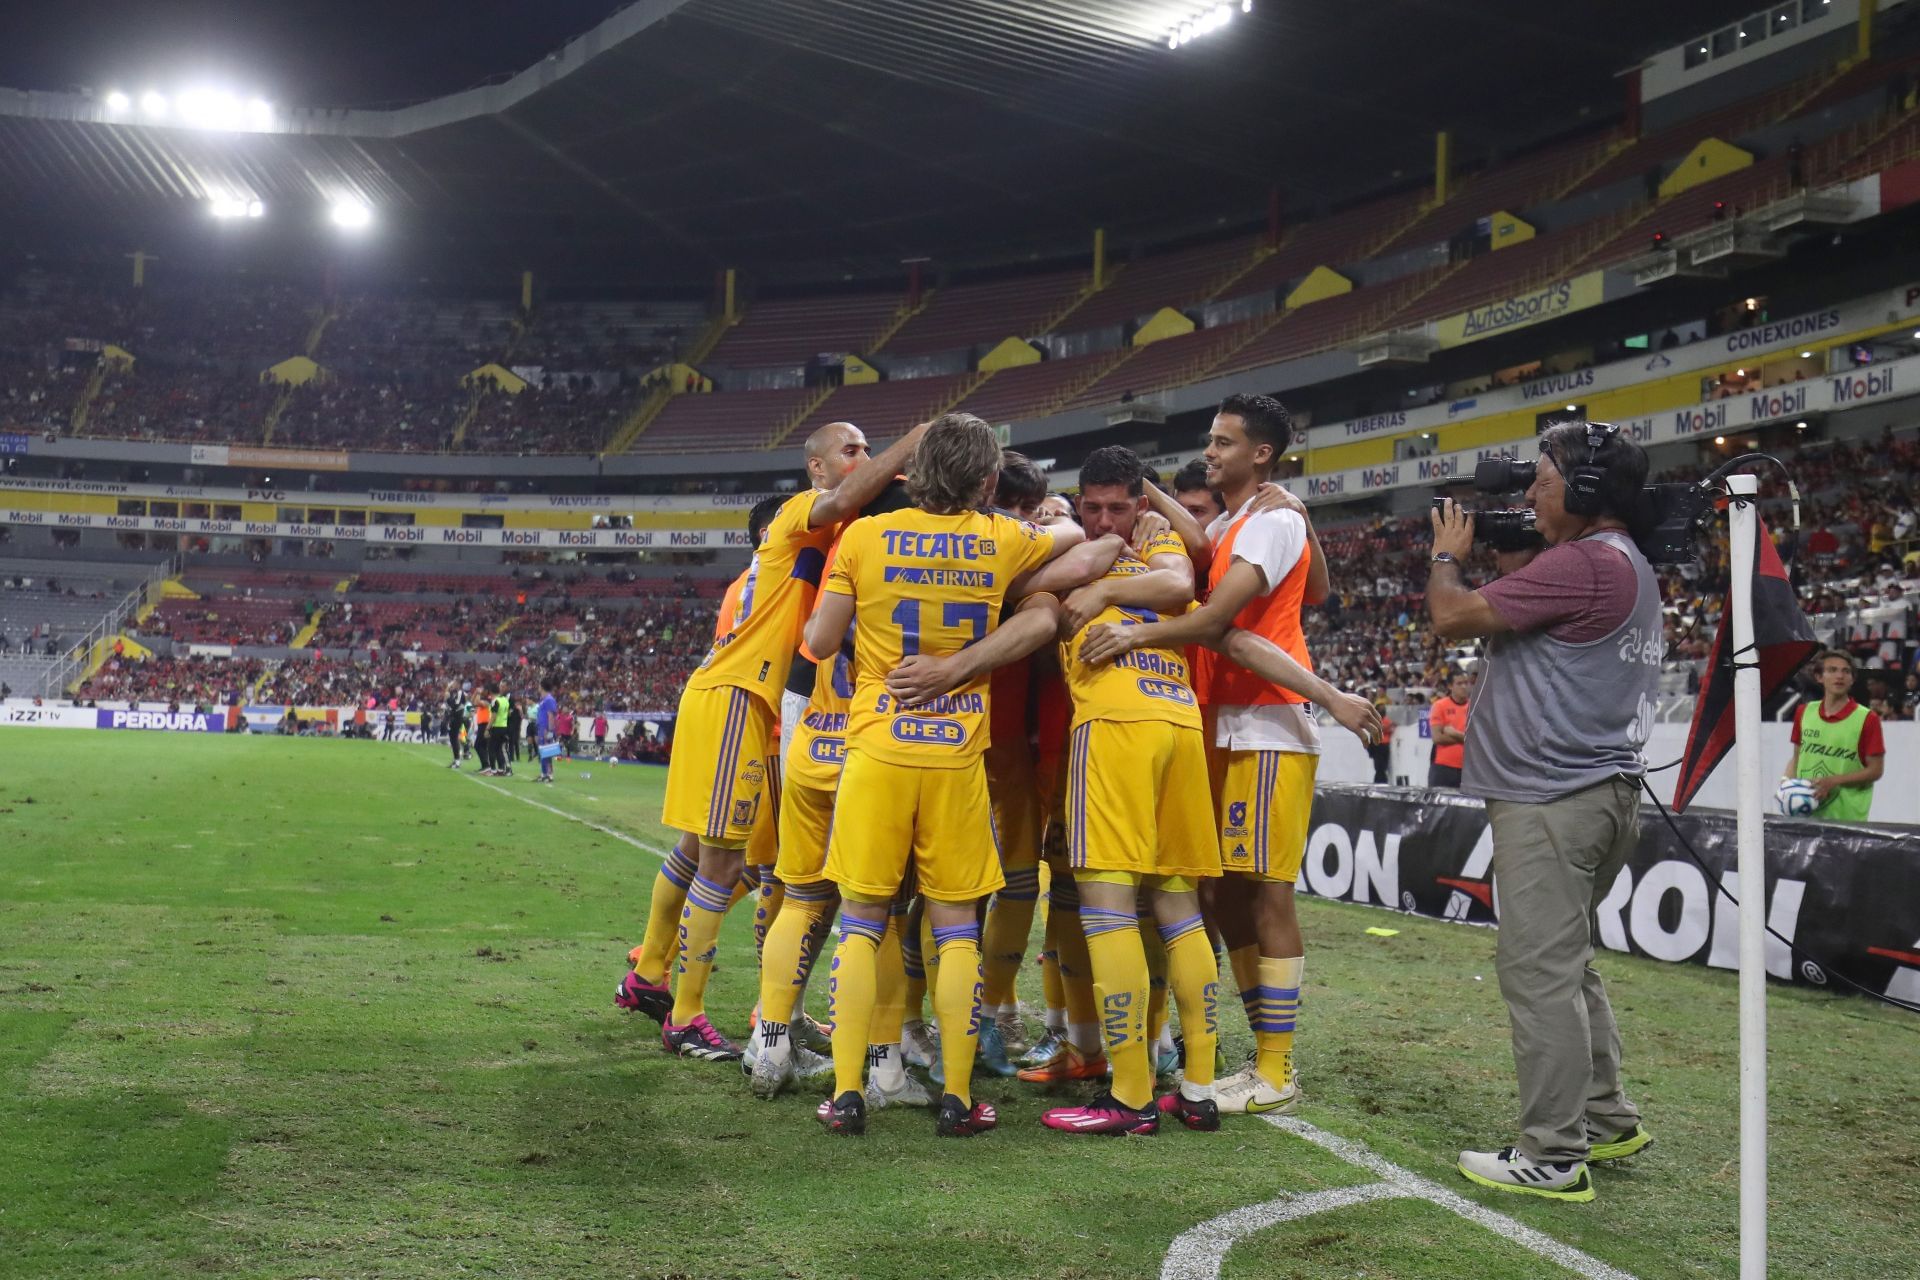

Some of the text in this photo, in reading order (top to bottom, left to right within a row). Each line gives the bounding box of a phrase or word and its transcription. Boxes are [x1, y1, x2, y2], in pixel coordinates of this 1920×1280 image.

[1727, 310, 1841, 352] CONEXIONES
[1522, 370, 1595, 400] VALVULAS
[1308, 474, 1344, 497] Mobil
[1362, 466, 1399, 488] Mobil
[1418, 456, 1458, 480] Mobil
[1675, 404, 1726, 435] Mobil
[1751, 387, 1806, 420] Mobil
[1833, 368, 1893, 403] Mobil
[1345, 412, 1407, 437] TUBERIAS
[247, 490, 286, 501] PVC
[9, 511, 751, 545] Mobil Mobil Mobil Mobil Mobil Mobil Mobil Mobil Mobil Mobil Mobil Mobil Mobil Mobil Mob
[881, 529, 980, 560] TECATE
[919, 569, 988, 587] AFIRME
[113, 711, 208, 731] PERDURA
[900, 721, 959, 739] H-E-B
[1805, 743, 1858, 761] ITALIKA
[1103, 991, 1132, 1047] viva
